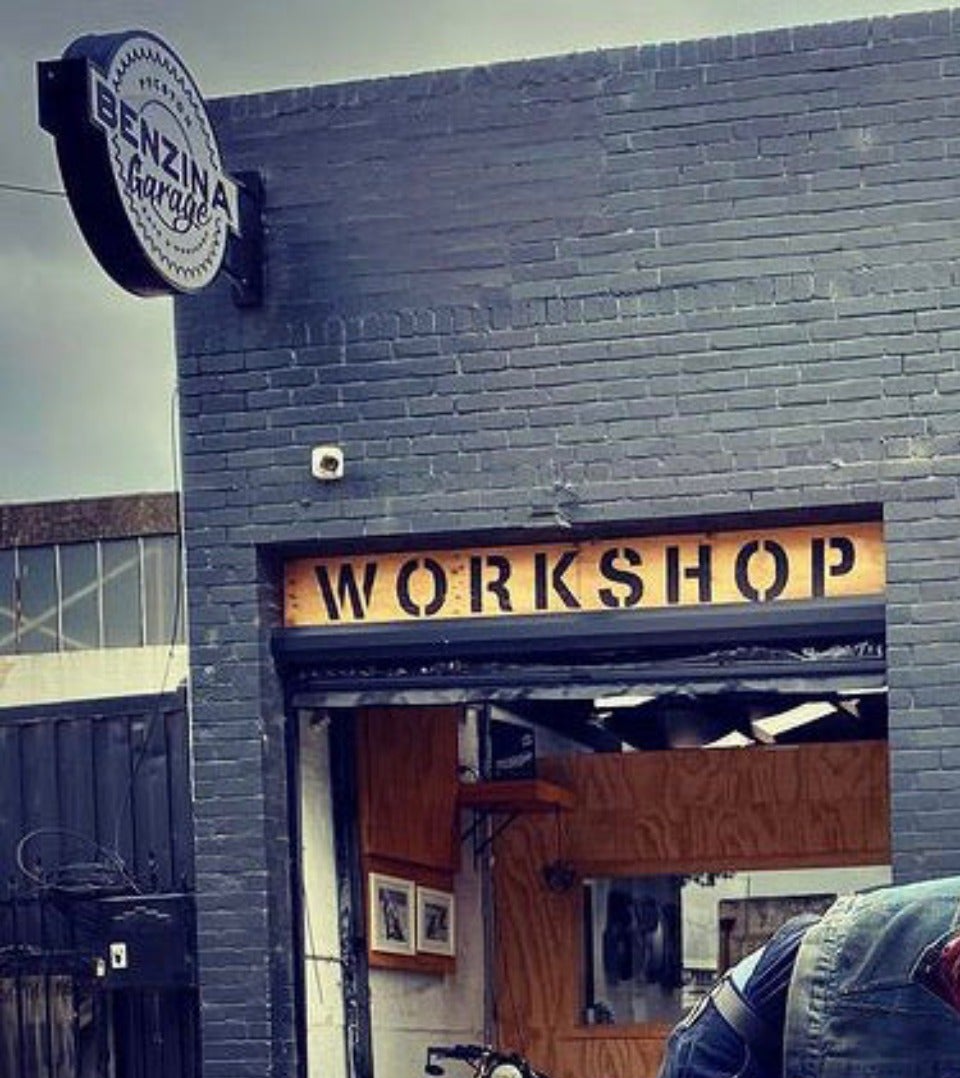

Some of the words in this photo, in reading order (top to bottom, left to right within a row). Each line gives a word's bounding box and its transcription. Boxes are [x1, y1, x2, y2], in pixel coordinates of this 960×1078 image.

[97, 82, 232, 222] BENZINA
[127, 153, 212, 233] Garage
[314, 536, 856, 621] WORKSHOP
